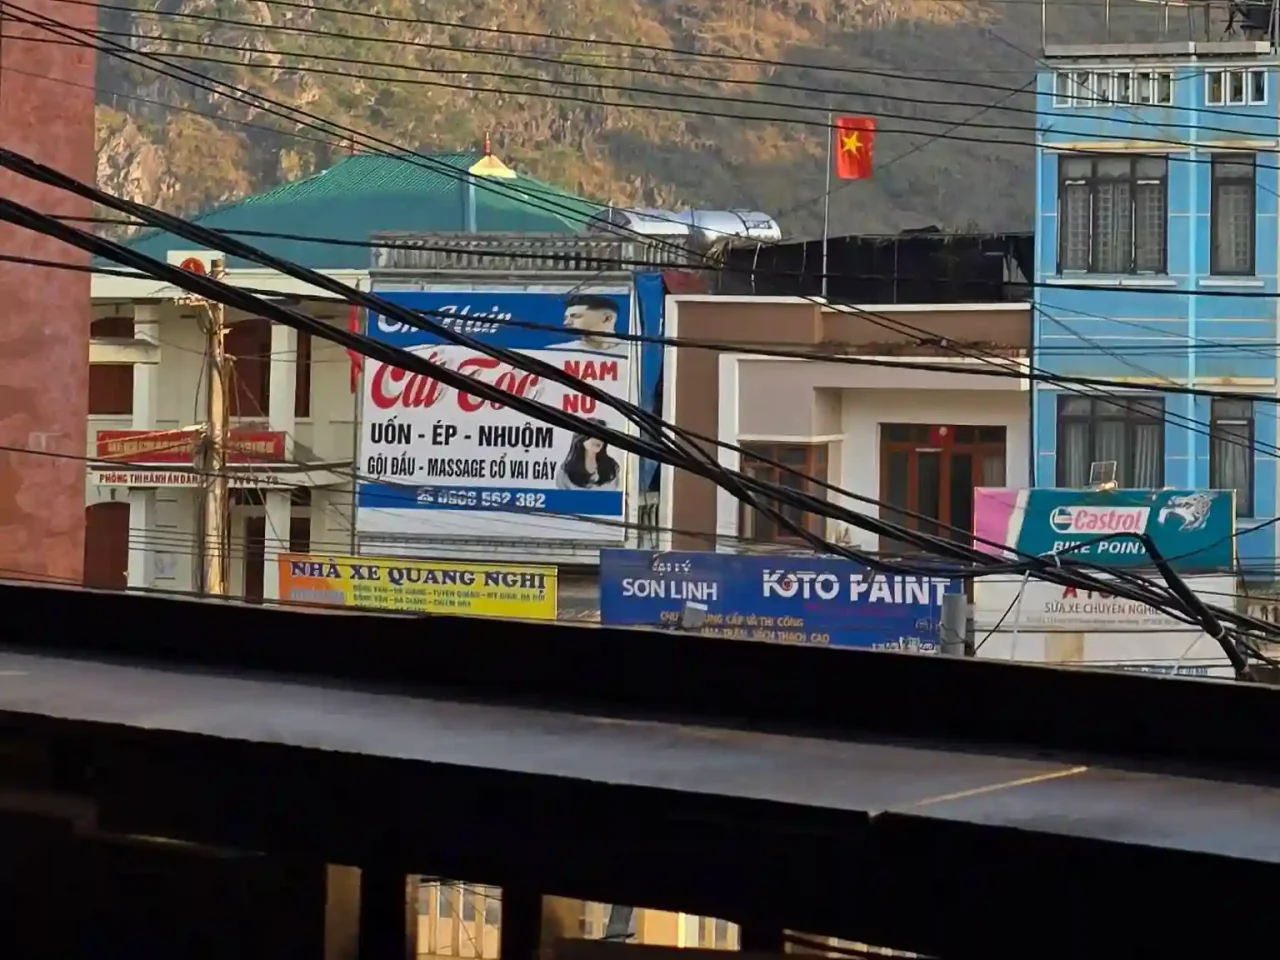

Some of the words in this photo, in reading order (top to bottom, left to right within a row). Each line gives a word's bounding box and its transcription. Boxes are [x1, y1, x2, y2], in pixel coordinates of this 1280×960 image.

[564, 360, 618, 381] NAM
[370, 415, 412, 445] UỐN
[431, 419, 458, 446] ÉP
[478, 422, 554, 453] NHUỘM
[367, 452, 388, 479] GỘI
[427, 458, 486, 479] MASSAGE
[489, 453, 507, 479] CỔ
[510, 461, 529, 480] VAI
[532, 457, 557, 481] GÁY
[515, 493, 546, 508] 382
[1074, 509, 1143, 531] Castrol
[291, 558, 342, 579] NHÀ
[350, 564, 381, 581] XE
[388, 566, 476, 586] QUANG
[484, 570, 546, 594] NGHỊ
[763, 569, 840, 600] KOTO
[850, 573, 951, 606] PAINT
[622, 578, 666, 598] SƠN
[670, 580, 718, 601] LINH
[1068, 602, 1081, 615] XE
